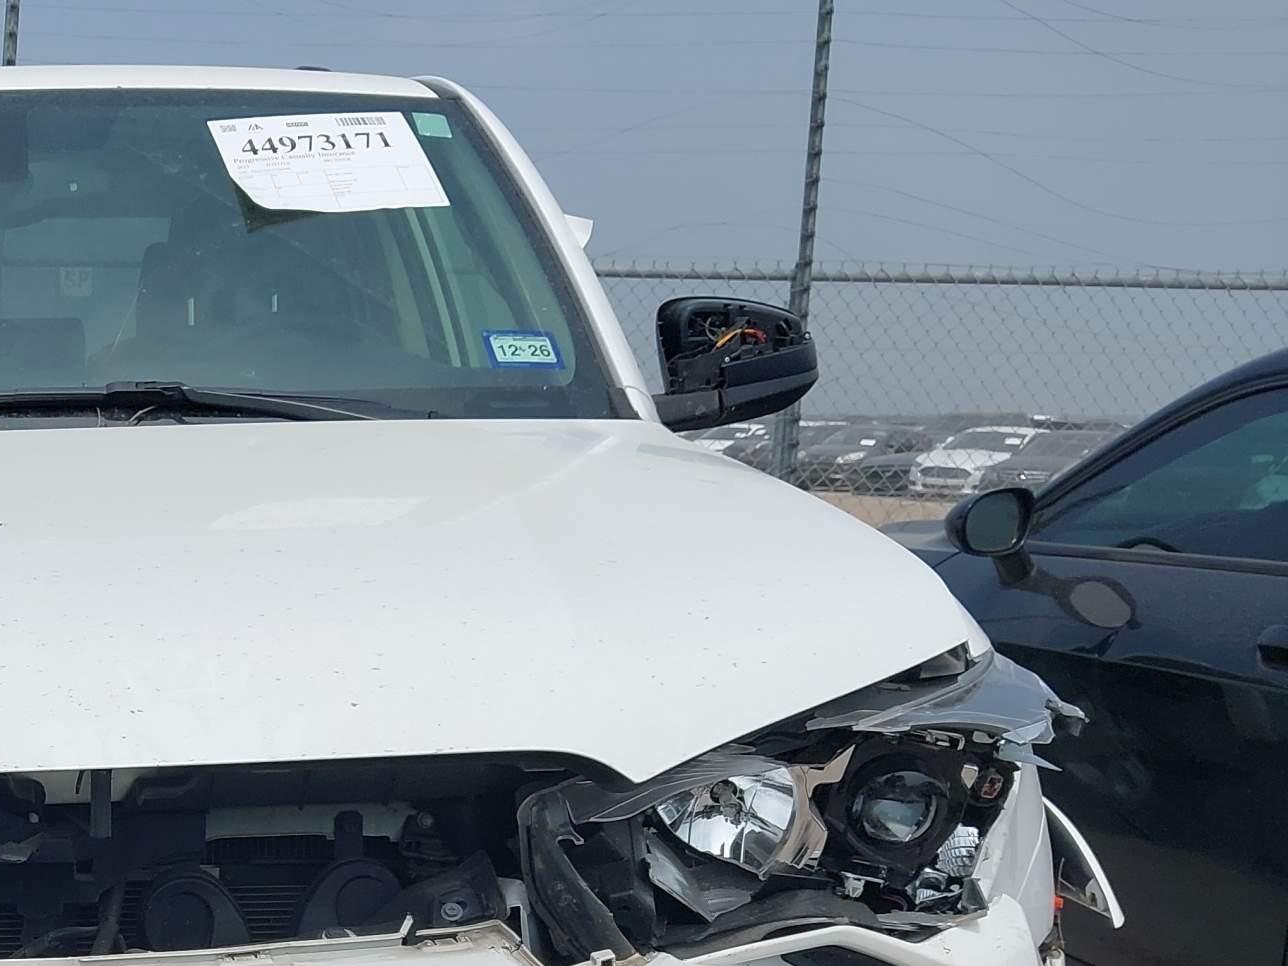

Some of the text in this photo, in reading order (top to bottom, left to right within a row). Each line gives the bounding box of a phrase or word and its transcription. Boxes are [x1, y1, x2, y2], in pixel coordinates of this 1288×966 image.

[241, 132, 392, 155] 44973171
[497, 344, 551, 357] 12 26
